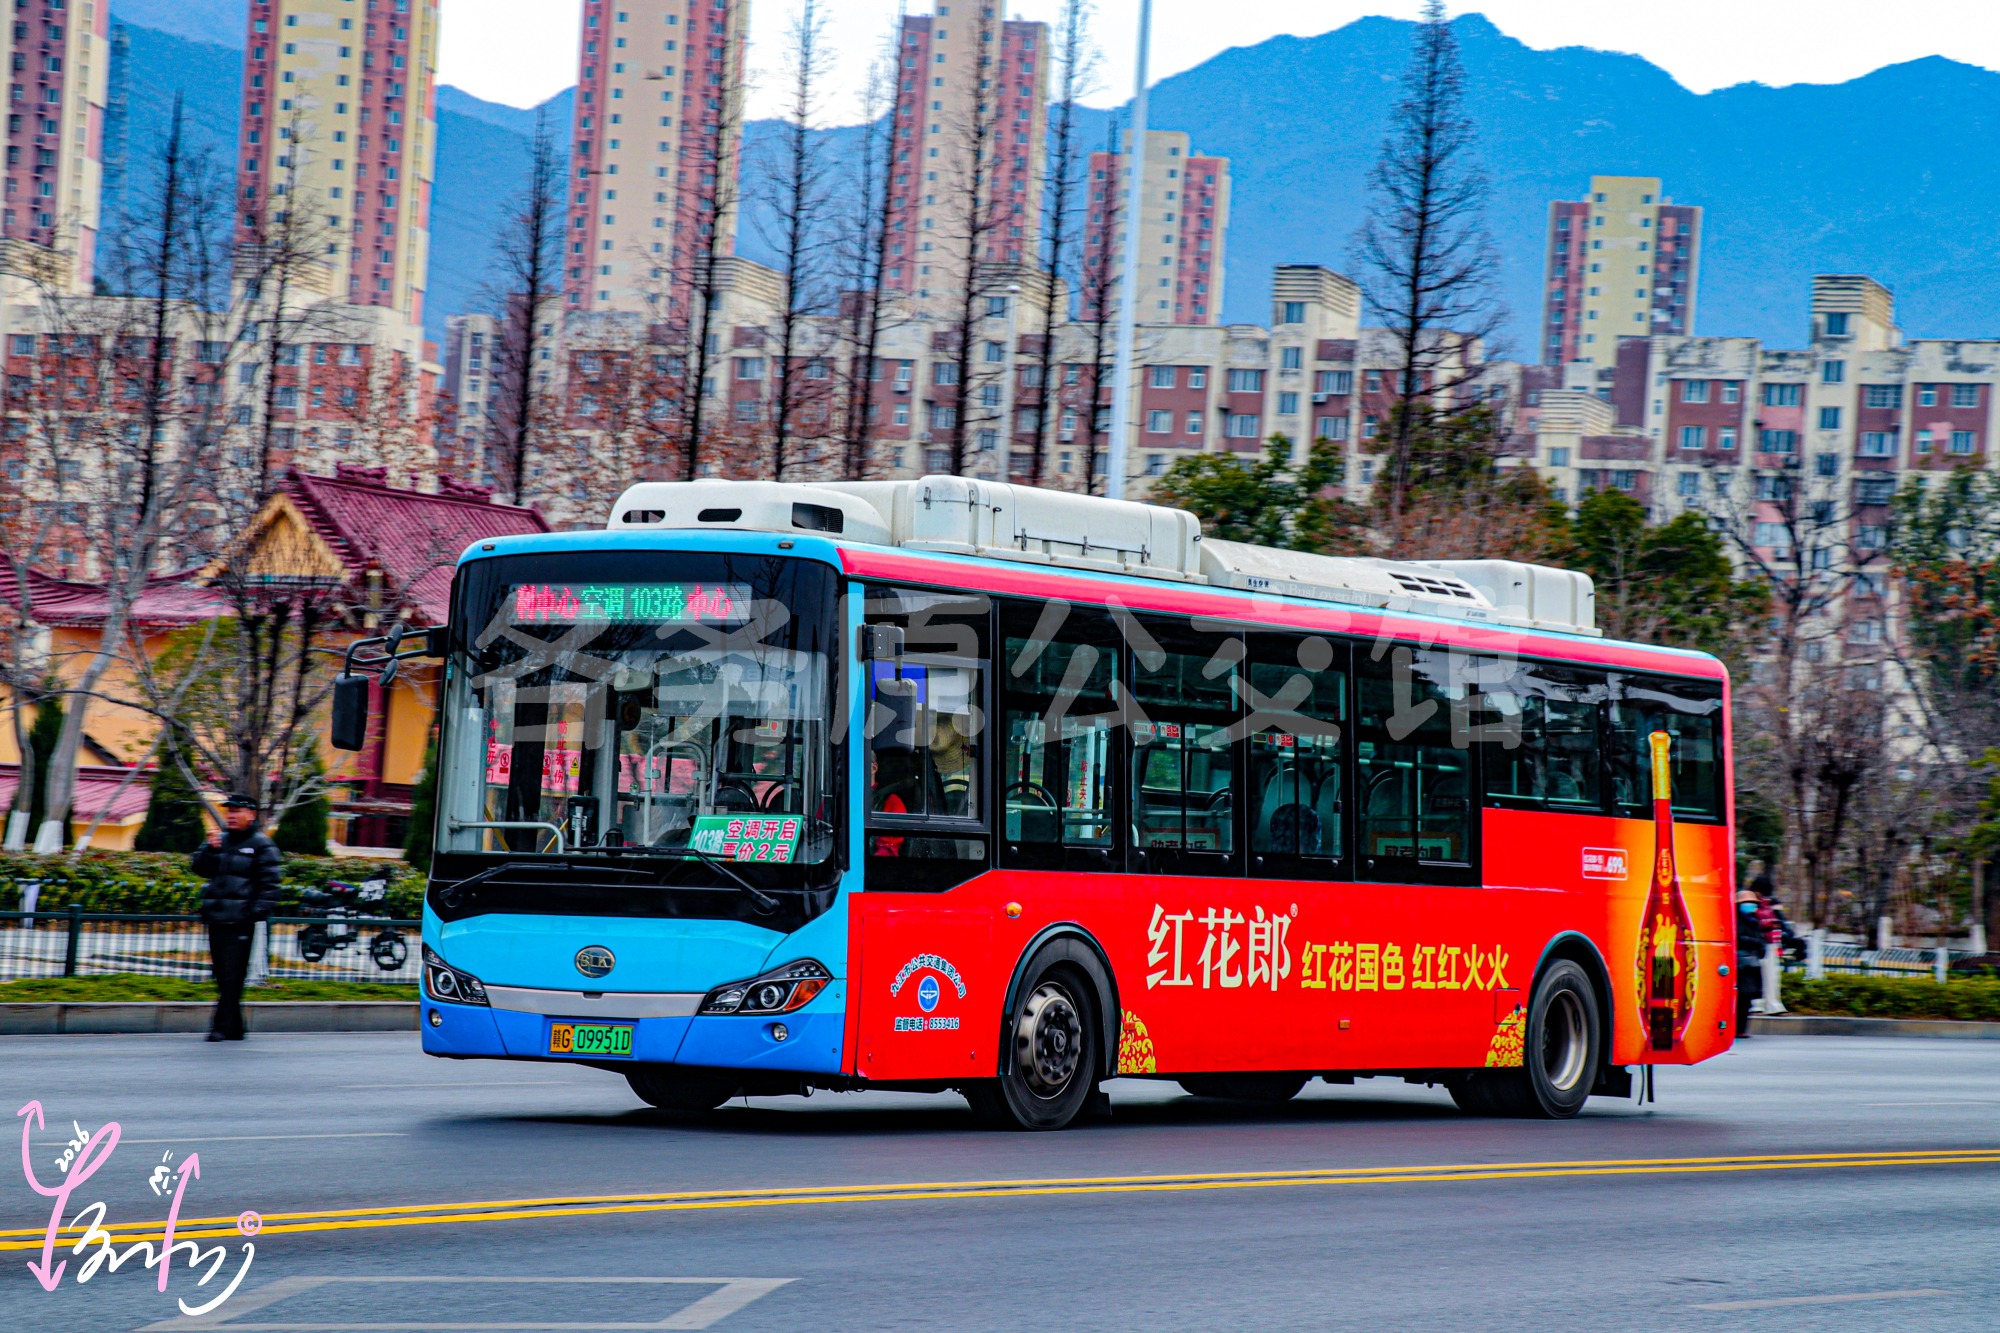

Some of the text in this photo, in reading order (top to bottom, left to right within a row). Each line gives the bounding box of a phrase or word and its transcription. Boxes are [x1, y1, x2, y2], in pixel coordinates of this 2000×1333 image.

[582, 585, 625, 619] 空调
[631, 586, 685, 619] 103路
[687, 585, 733, 620] 中心
[725, 819, 797, 840] 空调开启
[721, 841, 790, 861] 票价2元
[1145, 903, 1292, 992] 红花郎
[1300, 941, 1510, 992] 红花国色 红红火火
